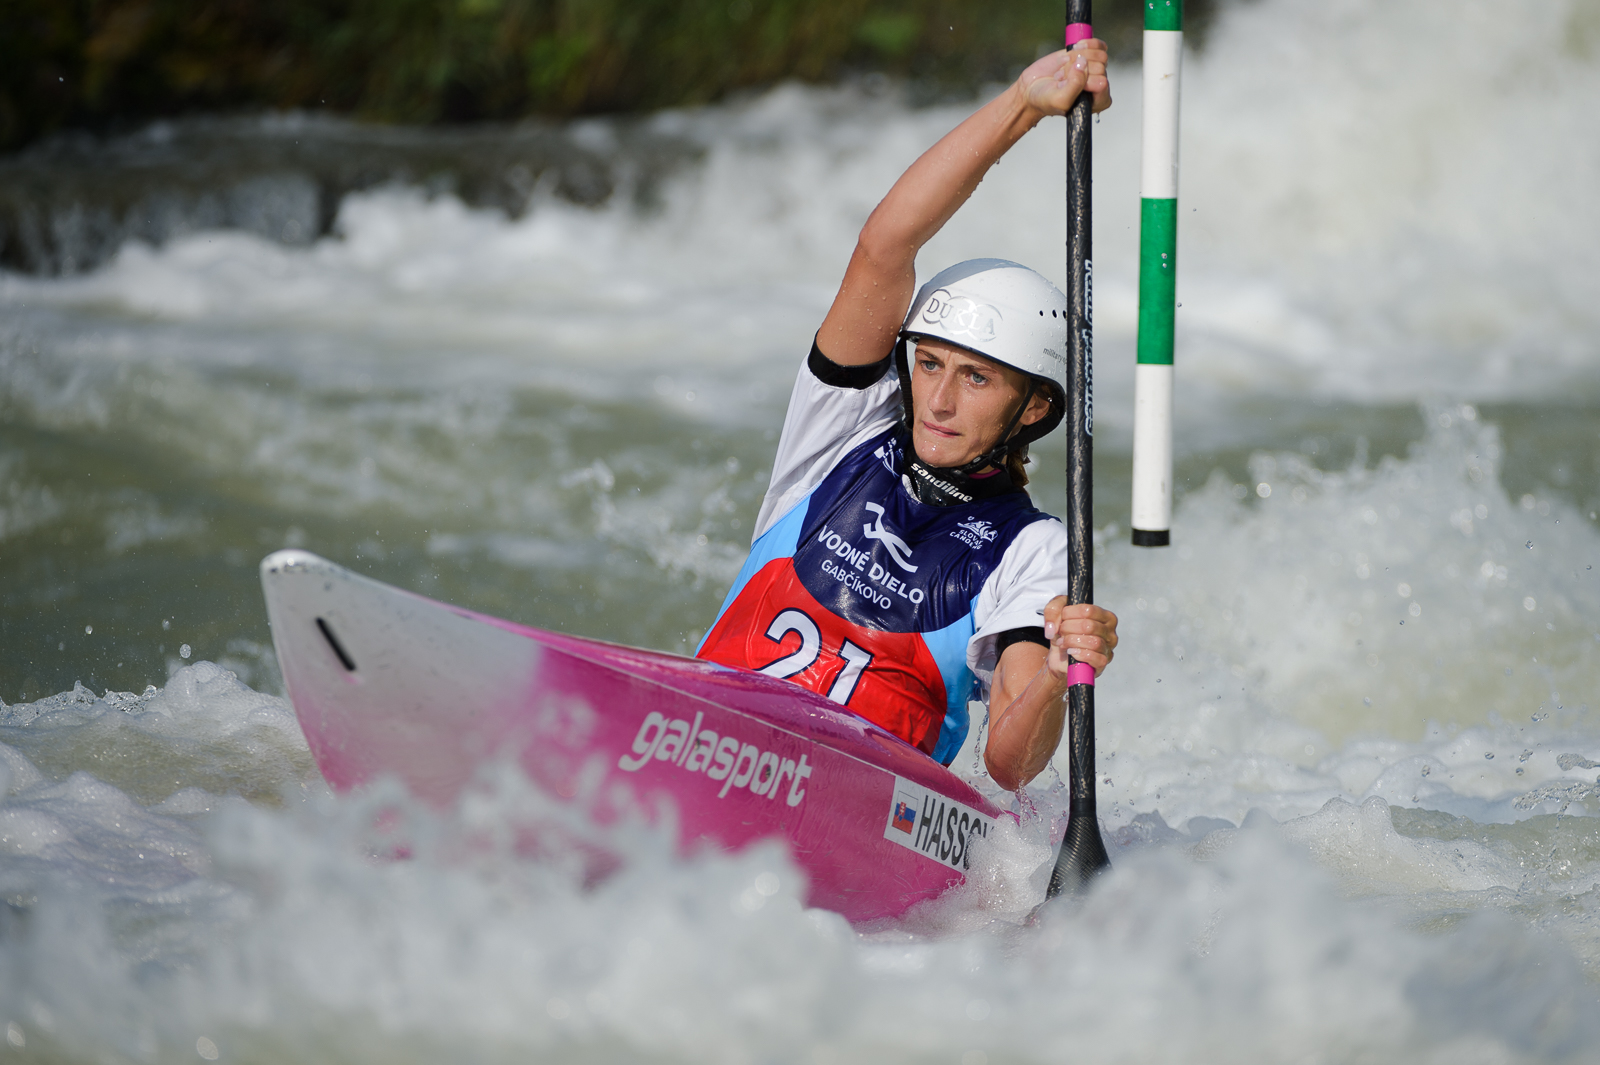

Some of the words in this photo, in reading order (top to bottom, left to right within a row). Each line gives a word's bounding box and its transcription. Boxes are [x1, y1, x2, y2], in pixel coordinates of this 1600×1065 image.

[926, 297, 995, 336] DUKLA
[910, 462, 973, 503] sandiline
[817, 524, 871, 572] VODNÉ
[867, 562, 924, 604] DIELO
[949, 531, 983, 550] CANOENG
[821, 559, 892, 609] GABČÍKOVO
[752, 607, 875, 706] 21
[618, 711, 813, 807] galasport
[914, 794, 995, 871] HASSO
